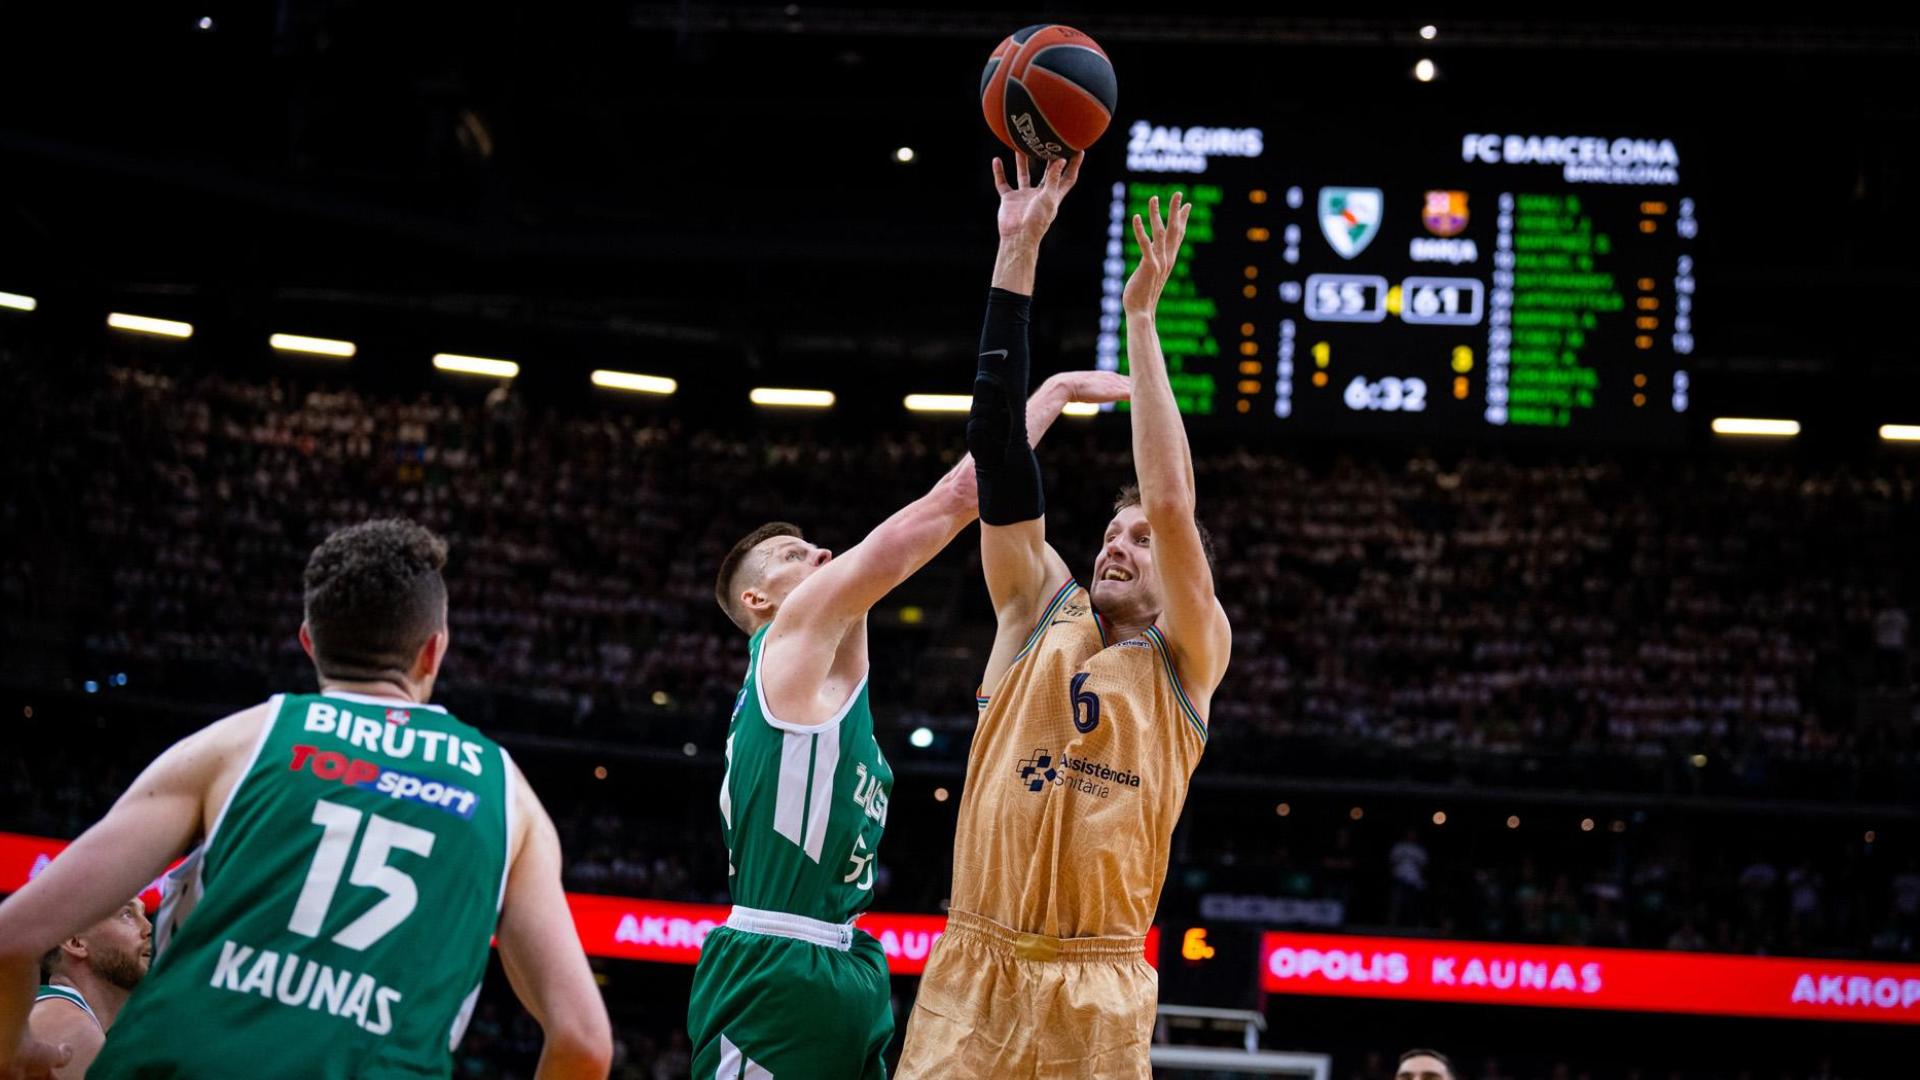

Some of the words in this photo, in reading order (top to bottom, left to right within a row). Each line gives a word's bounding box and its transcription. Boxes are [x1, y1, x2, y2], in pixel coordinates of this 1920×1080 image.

[1127, 120, 1264, 157] ŽALGIRIS
[1462, 134, 1502, 163] FC
[1503, 135, 1679, 166] BARCELONA
[1316, 281, 1366, 315] 55
[1412, 284, 1460, 317] 61
[1344, 376, 1427, 411] 6:32
[1069, 672, 1100, 734] 6
[304, 702, 484, 776] BIRUTIS
[1055, 770, 1109, 799] Snitària
[287, 799, 436, 952] 15
[614, 913, 716, 950] AKRO
[210, 940, 402, 1036] KAUNAS
[1268, 946, 1409, 985] OPOLIS
[1431, 956, 1602, 994] KAUNAS
[1791, 973, 1920, 1009] AKROP
